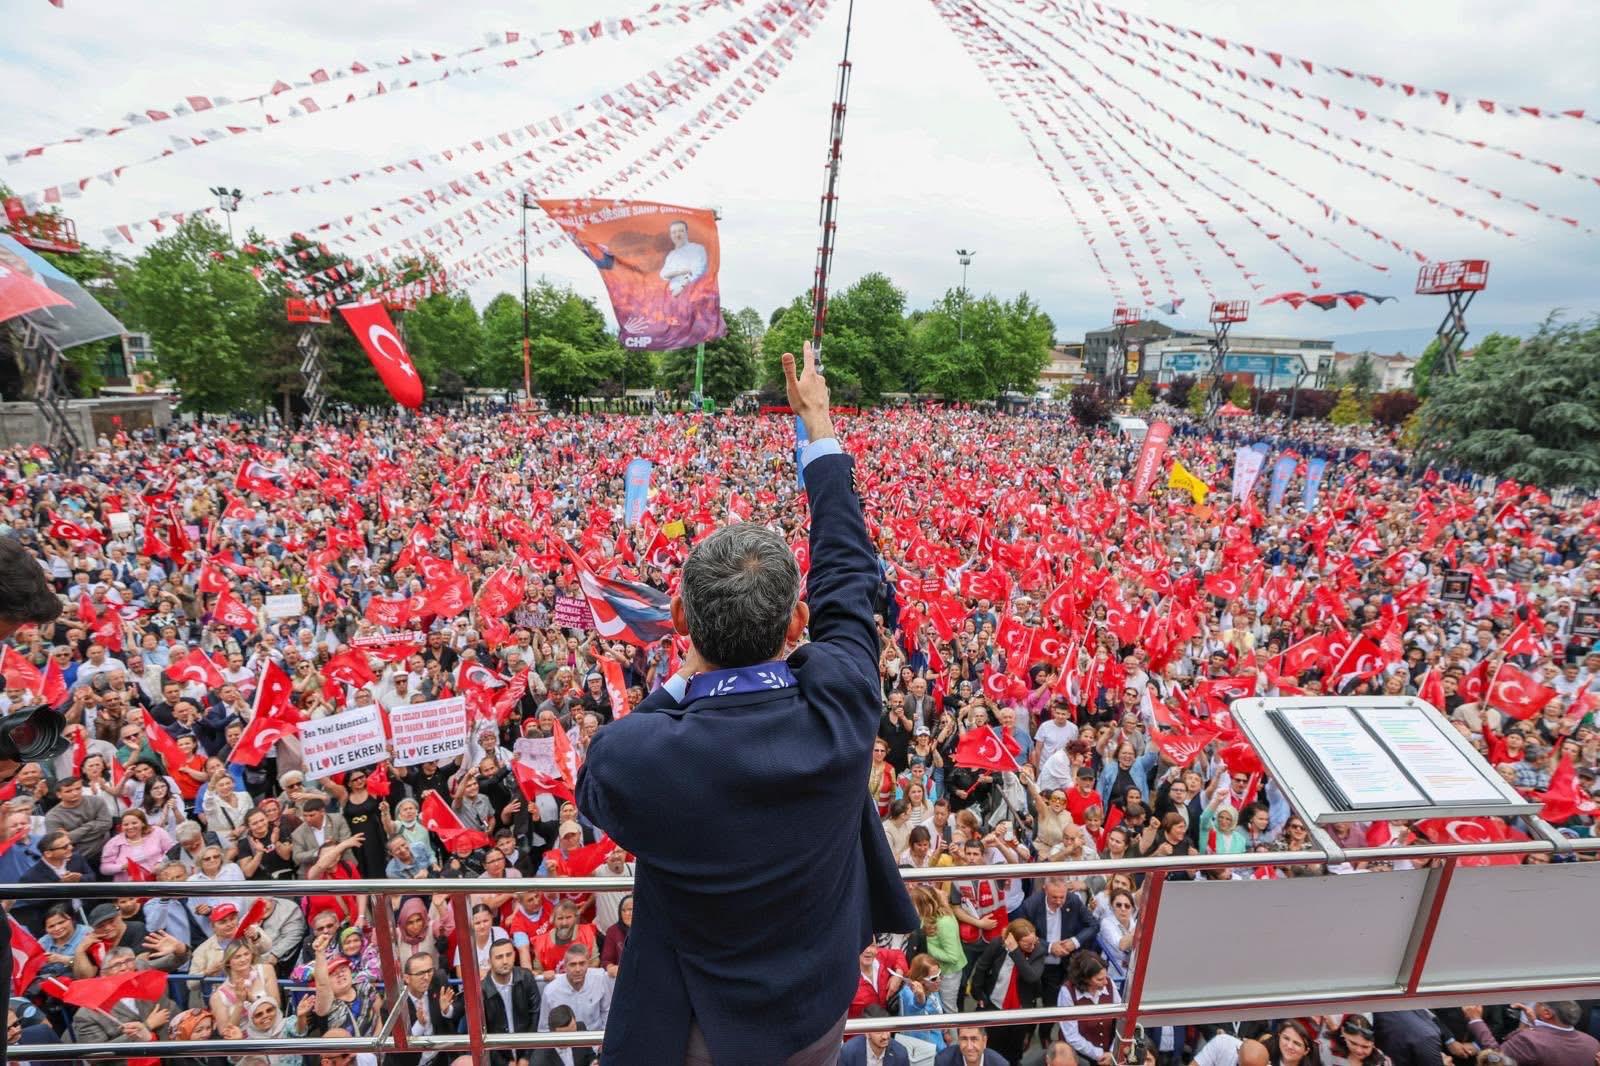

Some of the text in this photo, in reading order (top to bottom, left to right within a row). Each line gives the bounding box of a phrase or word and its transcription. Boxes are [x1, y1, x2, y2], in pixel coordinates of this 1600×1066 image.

[625, 336, 652, 348] CHP
[304, 729, 316, 738] Sen
[348, 743, 384, 761] EKREM
[432, 739, 464, 753] EKREM
